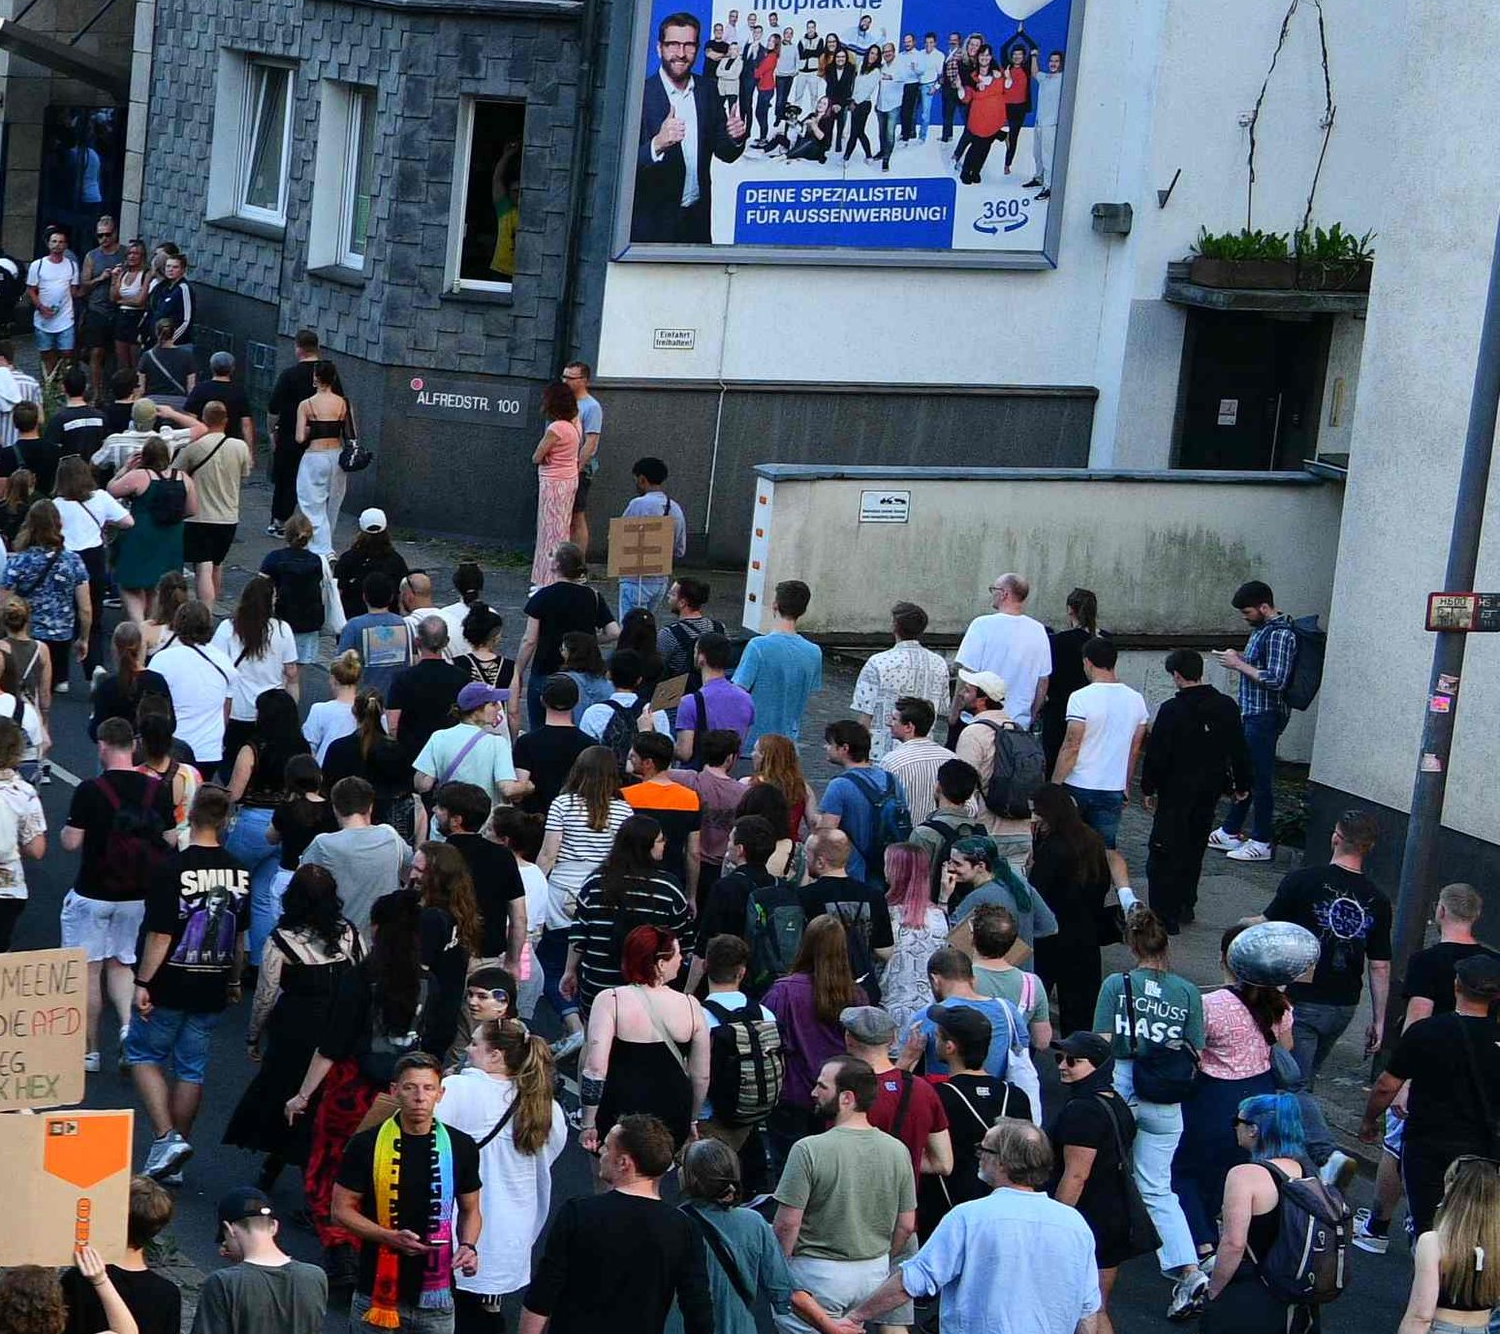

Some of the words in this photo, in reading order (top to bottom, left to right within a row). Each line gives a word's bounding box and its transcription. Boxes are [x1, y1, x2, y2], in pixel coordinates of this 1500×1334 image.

[745, 187, 796, 203] DEINE
[800, 186, 918, 203] SPEZIALISTEN
[745, 205, 781, 224] FÜR
[783, 206, 947, 225] AUSSENWERBUNG!
[983, 198, 1030, 220] 360°
[416, 391, 490, 411] ALFREDSTR.
[497, 399, 520, 415] 100
[179, 869, 250, 897] SMILE
[1, 960, 80, 998] MEENE
[30, 1006, 82, 1037] AFD
[15, 1075, 60, 1100] HEX
